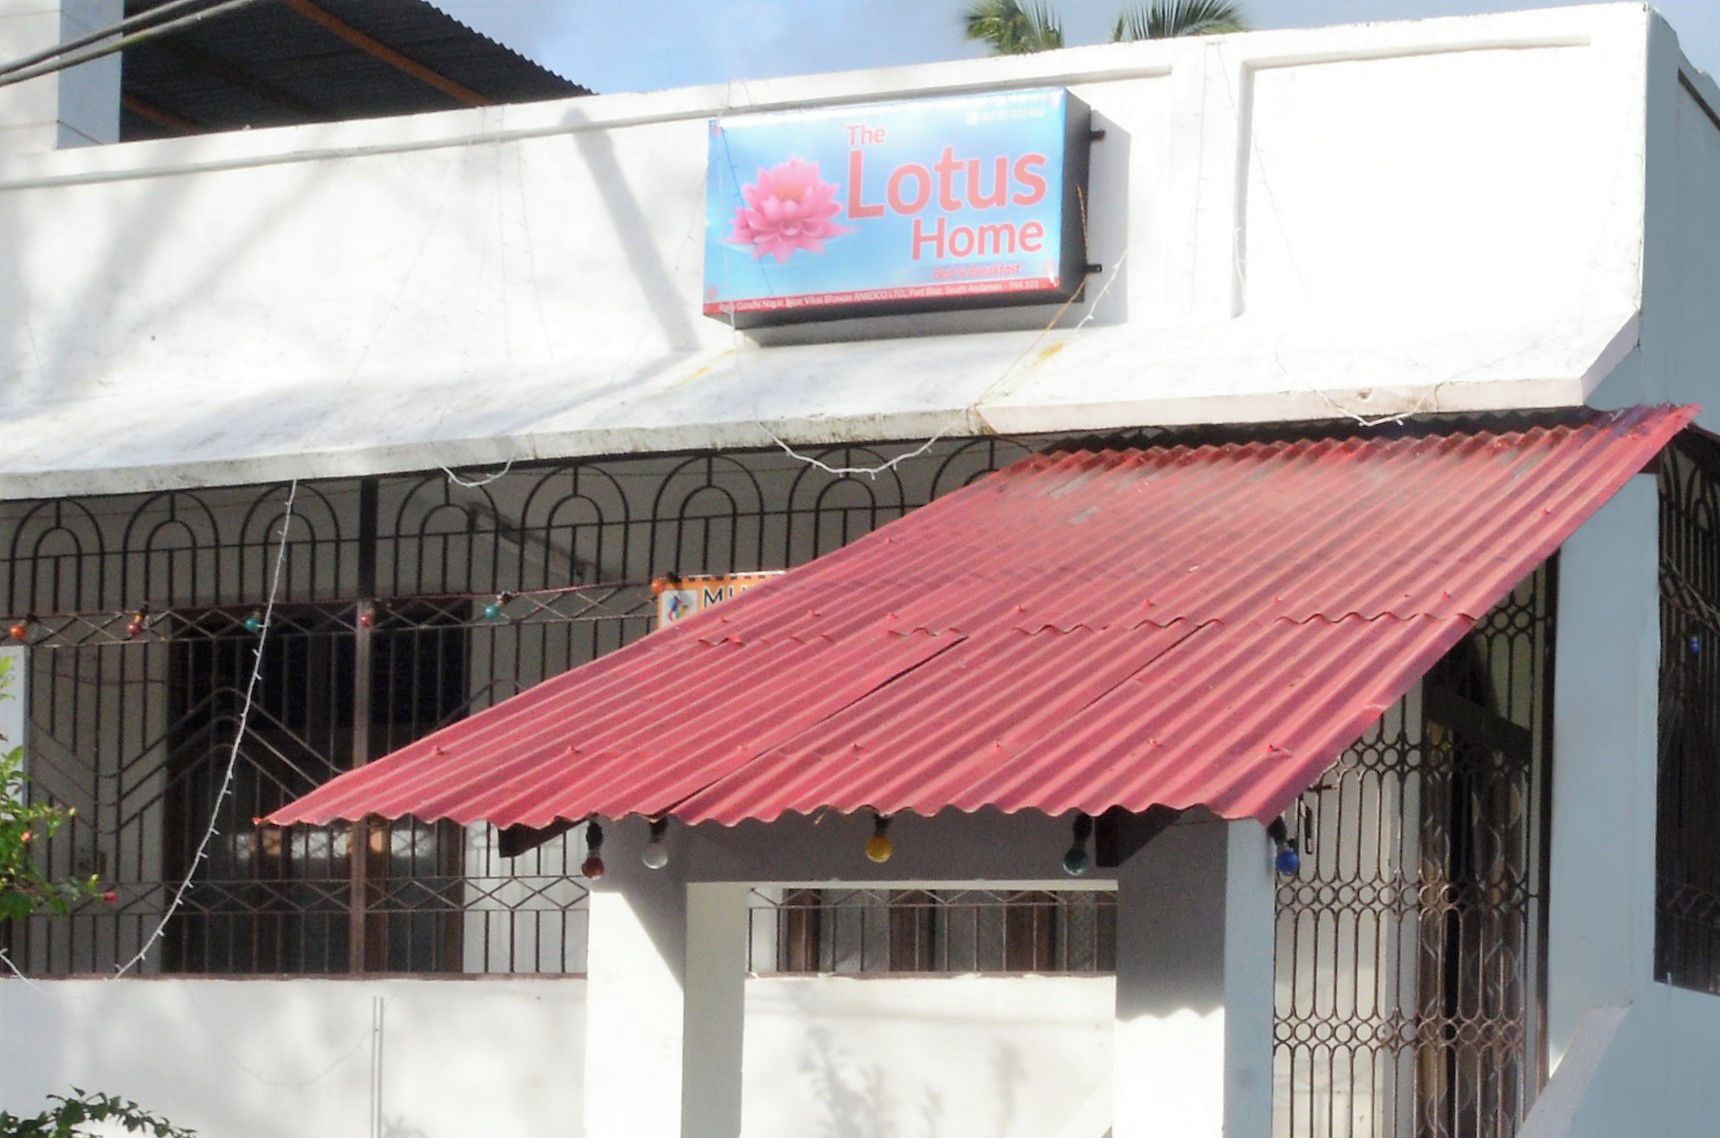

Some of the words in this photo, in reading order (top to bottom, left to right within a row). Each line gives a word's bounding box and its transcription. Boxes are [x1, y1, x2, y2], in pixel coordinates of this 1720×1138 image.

[847, 125, 887, 145] The
[848, 147, 1047, 219] Lotus
[912, 217, 1044, 260] Home
